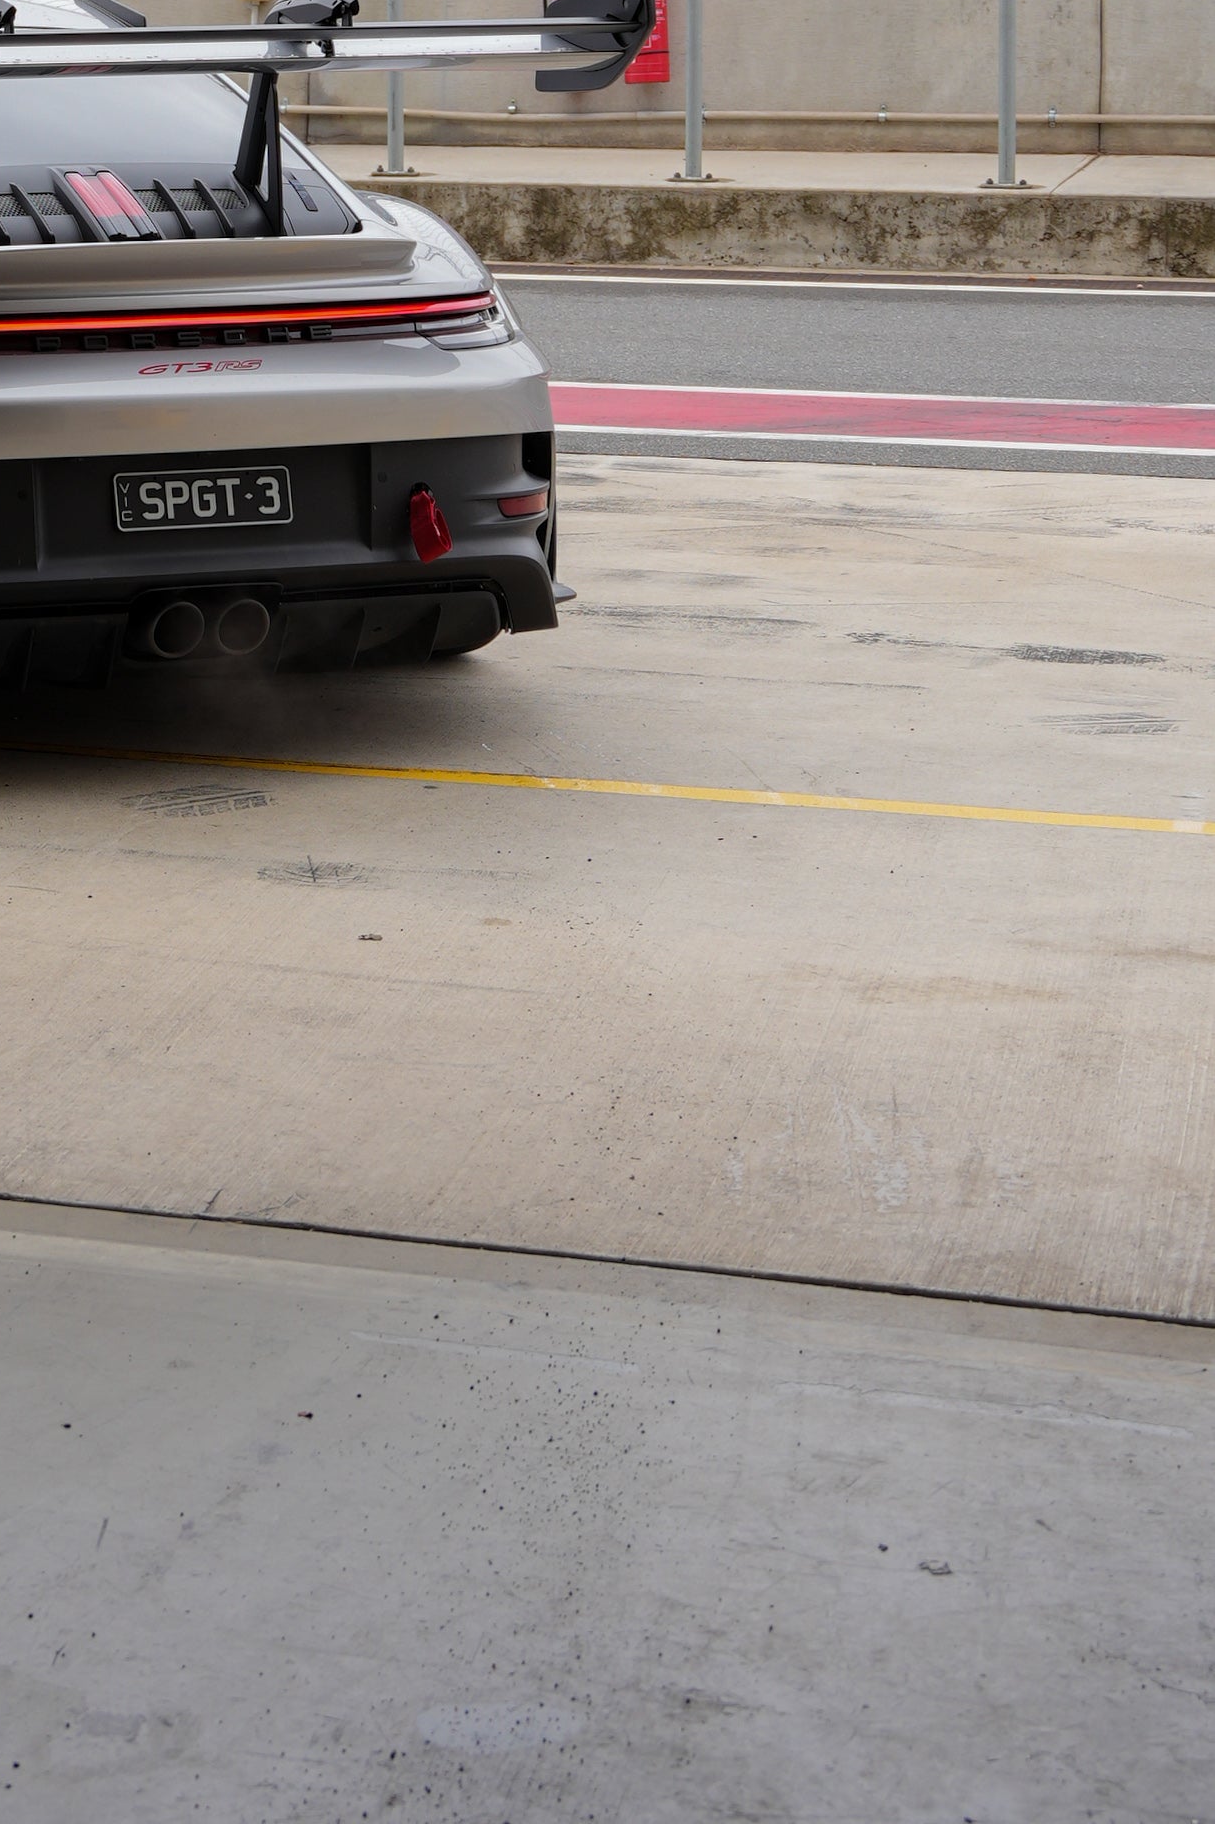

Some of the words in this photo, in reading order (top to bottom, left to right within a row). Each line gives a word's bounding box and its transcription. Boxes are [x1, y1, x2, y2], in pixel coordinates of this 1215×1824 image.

[119, 482, 133, 522] VIC
[139, 477, 241, 521] SPGT
[256, 476, 281, 515] 3
